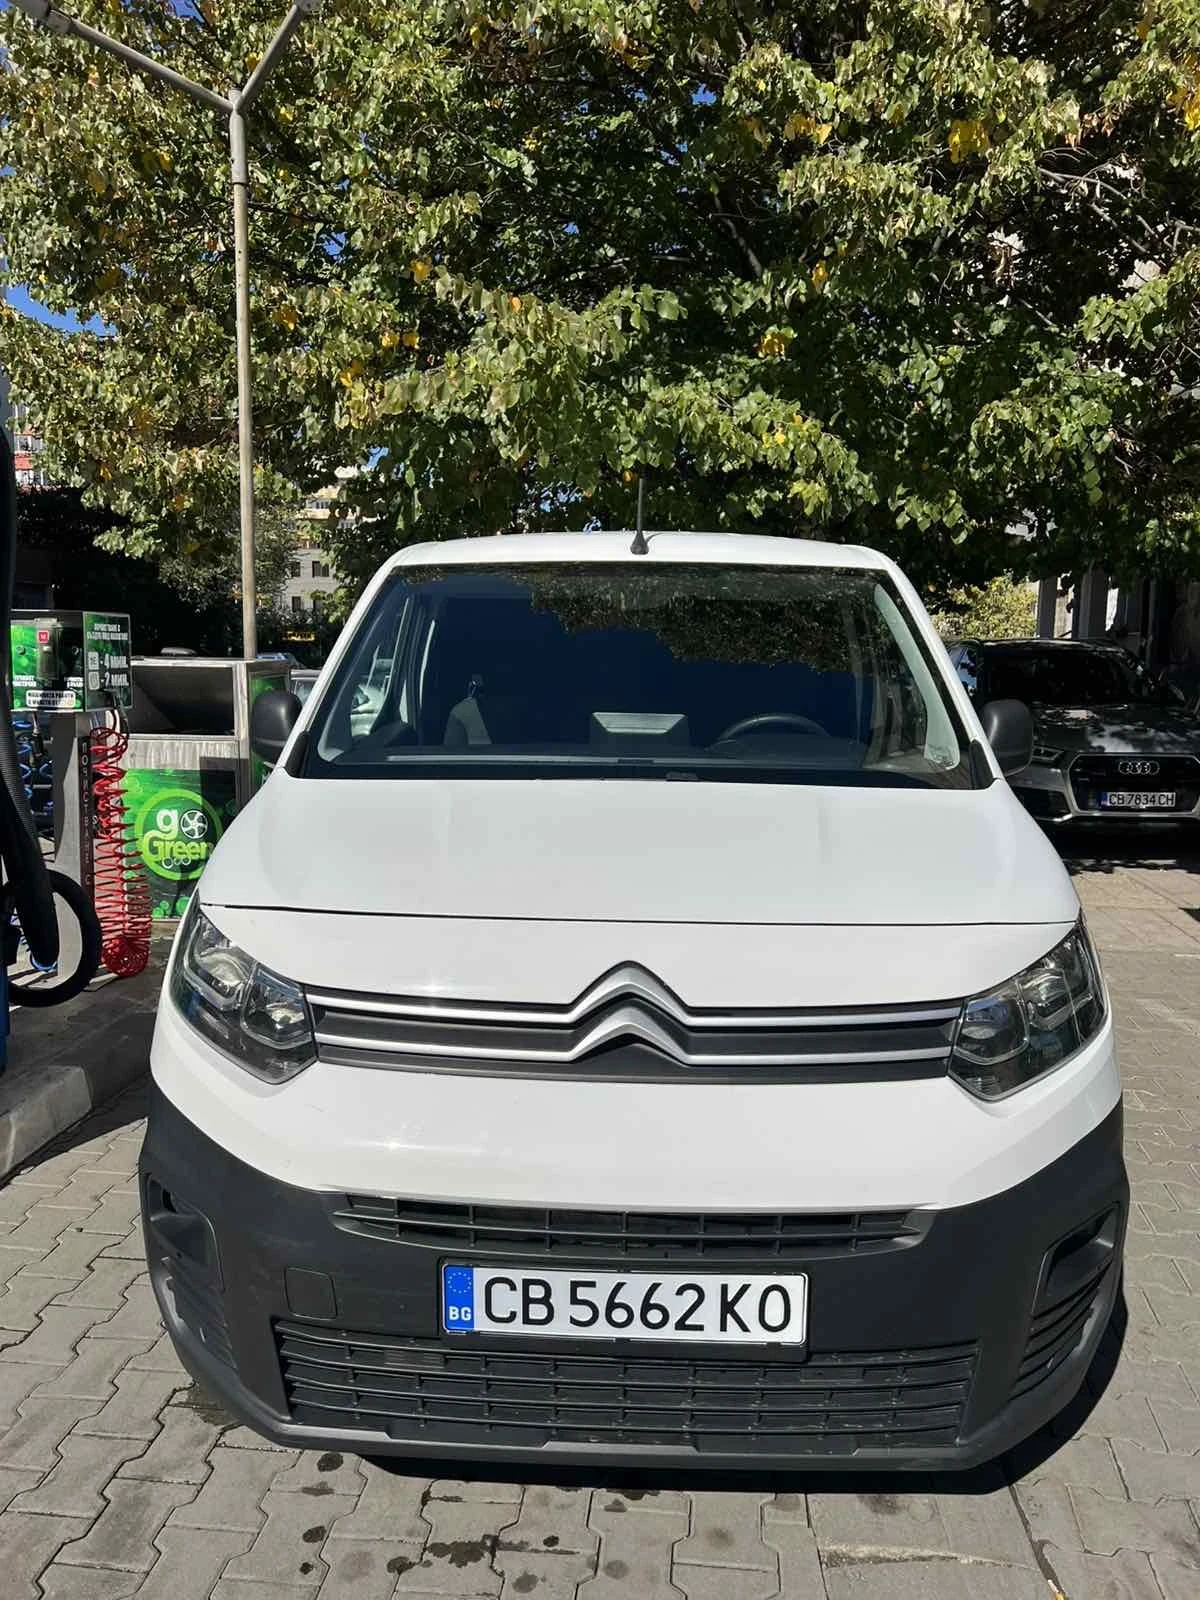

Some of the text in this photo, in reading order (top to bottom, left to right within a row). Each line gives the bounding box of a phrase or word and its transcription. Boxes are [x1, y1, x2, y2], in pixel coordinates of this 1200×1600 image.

[1109, 793, 1125, 806] CB
[1158, 793, 1175, 806] CH
[448, 1305, 472, 1321] BG
[484, 1276, 555, 1326] CB
[568, 1279, 705, 1331] 5662
